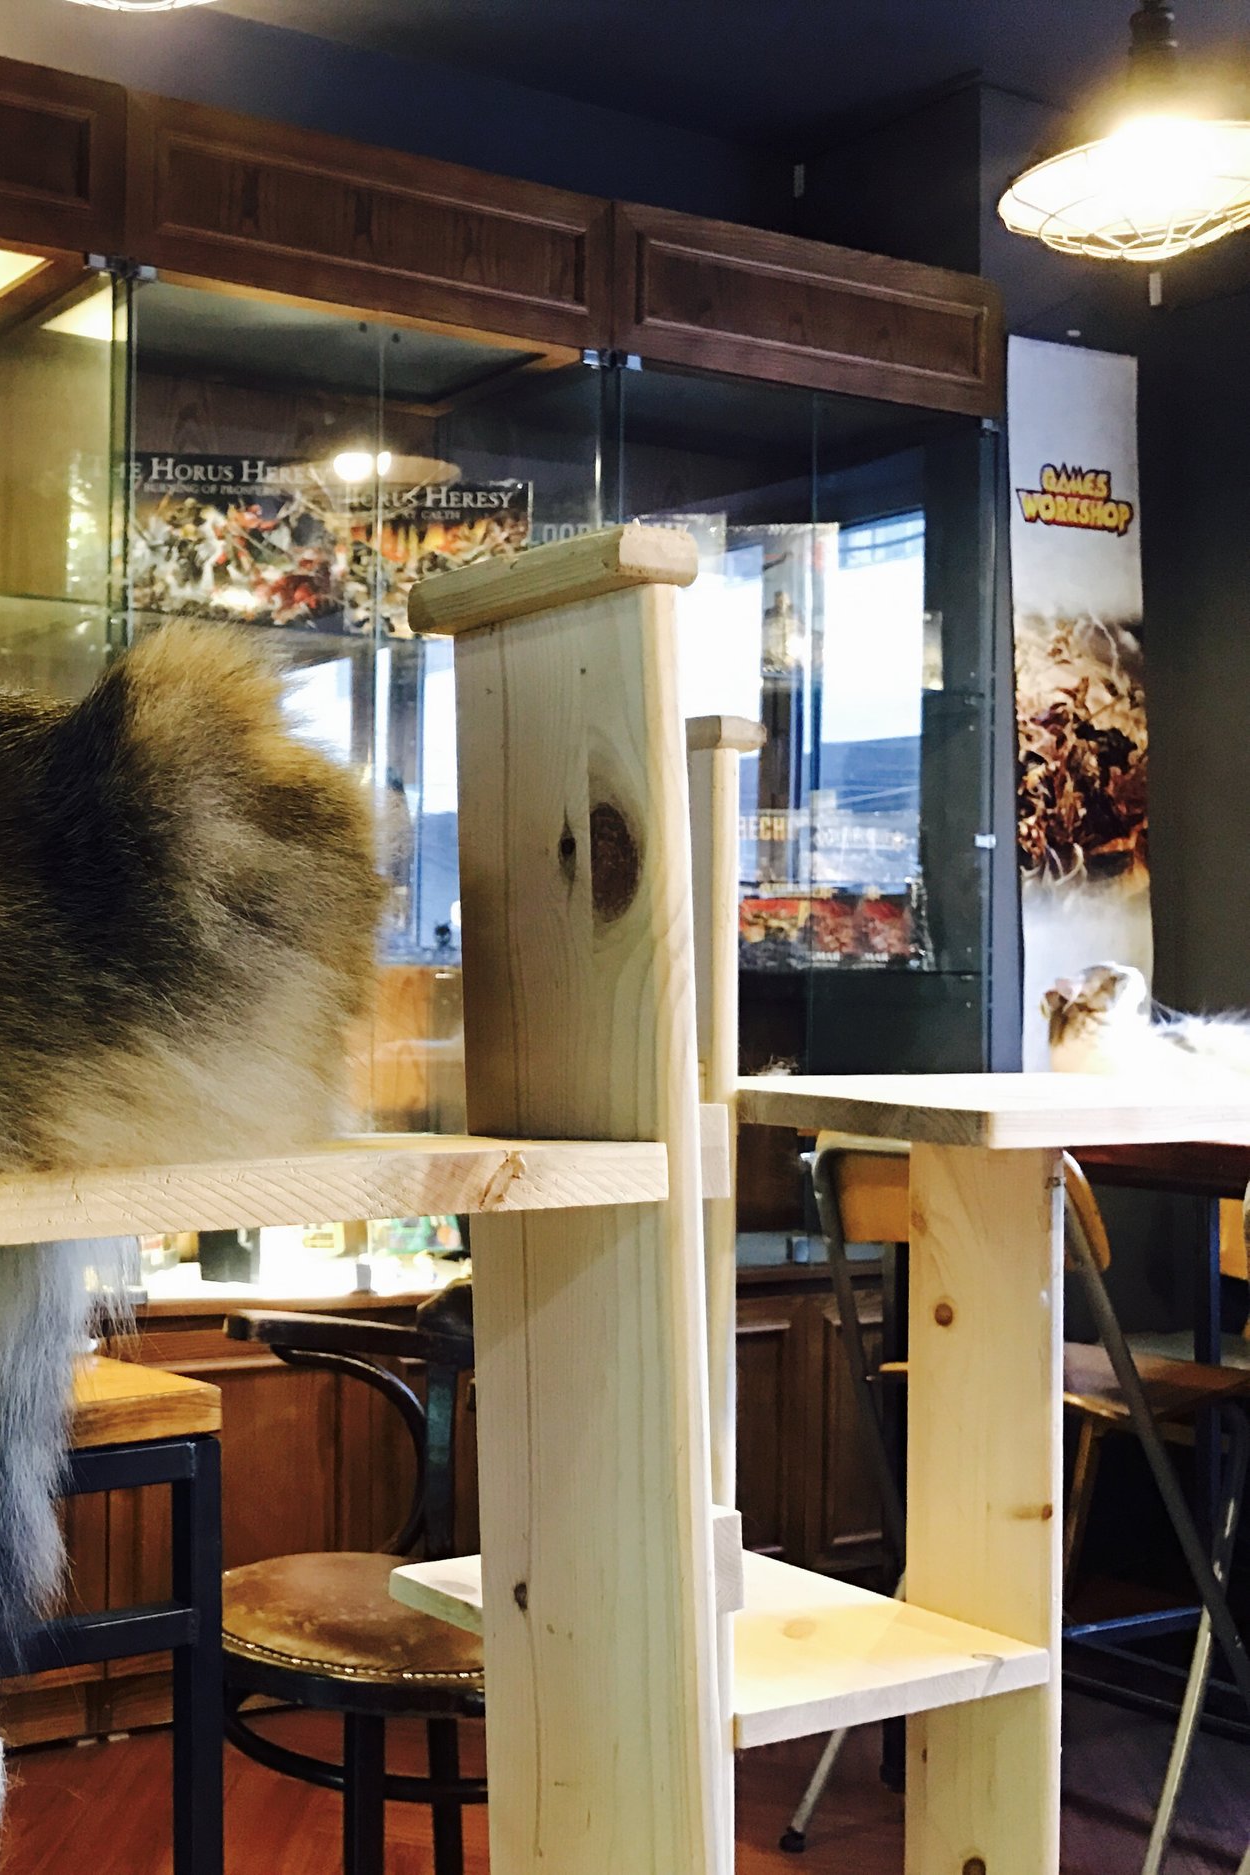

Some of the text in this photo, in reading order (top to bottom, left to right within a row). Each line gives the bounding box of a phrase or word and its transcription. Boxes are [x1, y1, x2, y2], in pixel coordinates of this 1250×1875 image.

[151, 457, 234, 481] HORUS
[1040, 463, 1111, 498] GAMES
[425, 485, 512, 509] HERESY
[1017, 489, 1133, 536] WORKSHOP
